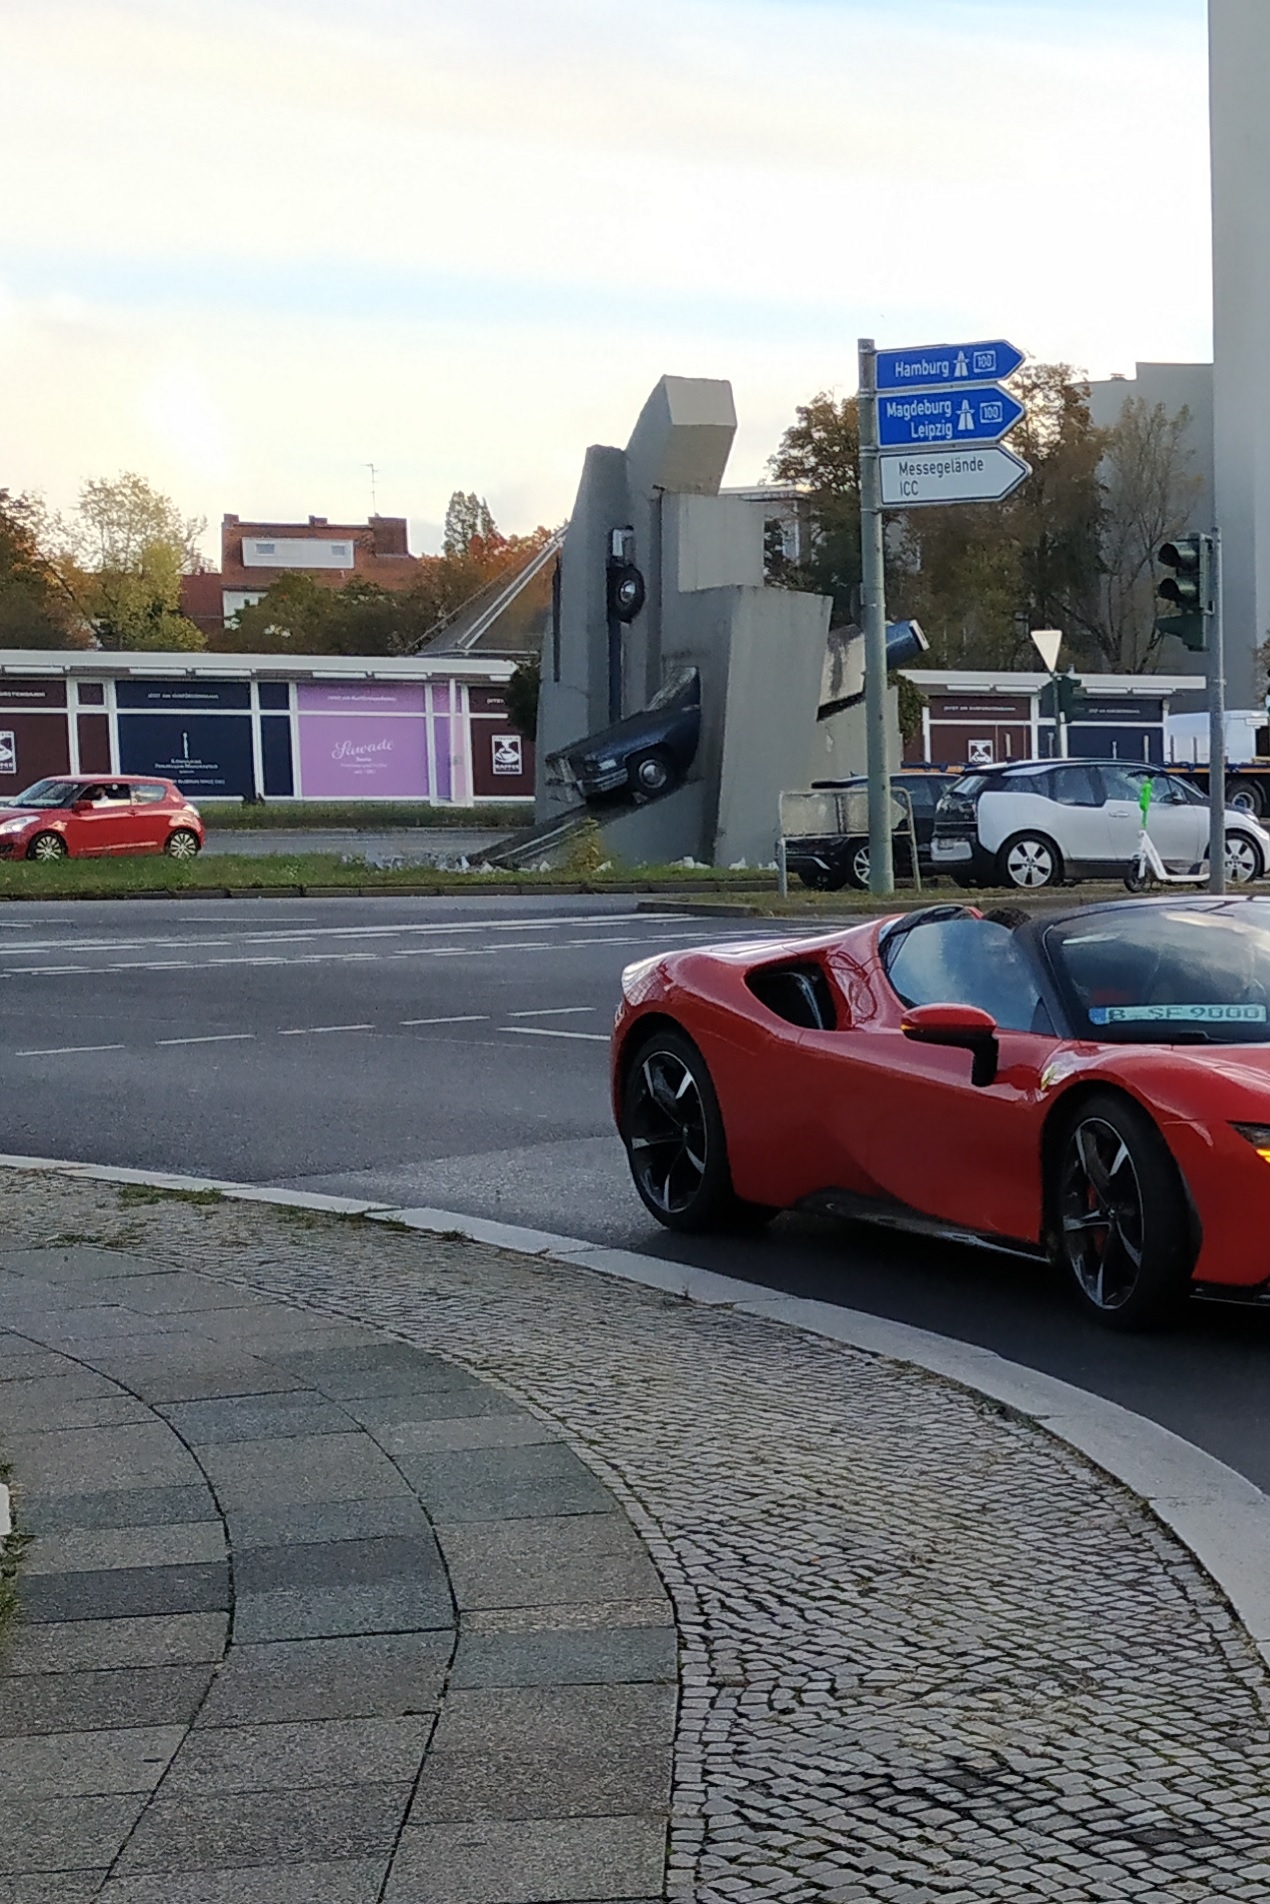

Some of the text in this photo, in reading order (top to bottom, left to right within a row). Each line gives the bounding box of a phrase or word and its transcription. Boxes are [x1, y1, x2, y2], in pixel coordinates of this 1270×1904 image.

[895, 355, 992, 378] Hamburg 100
[886, 400, 998, 421] Magdeburg 100
[911, 420, 952, 440] Leipzig
[899, 457, 984, 477] Messegelände
[900, 480, 919, 496] ICC
[1108, 1007, 1260, 1021] B SF 9000
